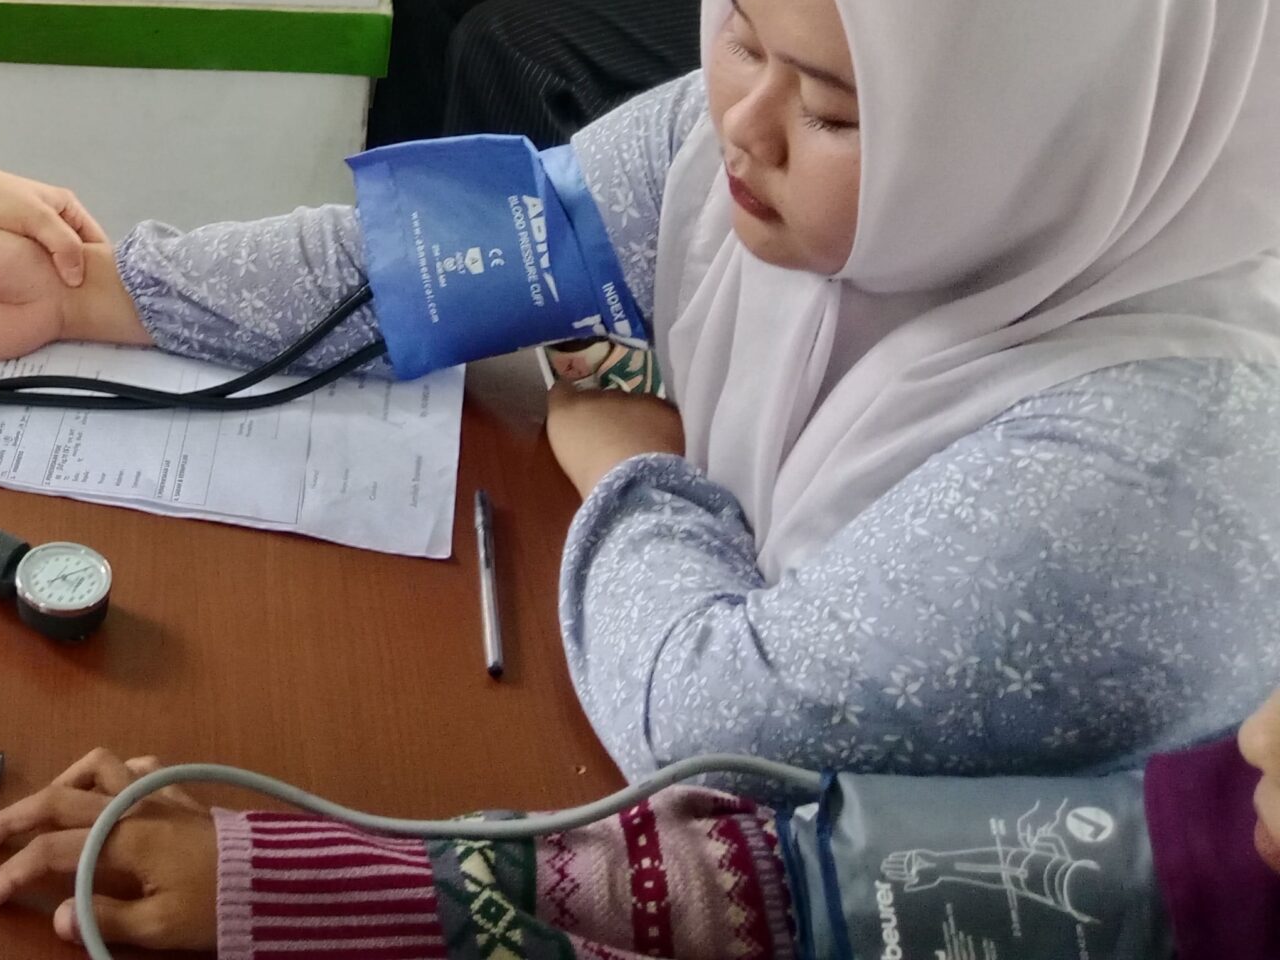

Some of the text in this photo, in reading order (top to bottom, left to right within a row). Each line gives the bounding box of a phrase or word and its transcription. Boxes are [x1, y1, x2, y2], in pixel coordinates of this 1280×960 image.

[507, 194, 545, 308] BLOOD PRESSURE CUFF
[601, 281, 624, 322] INDEX
[875, 880, 902, 960] beurer
